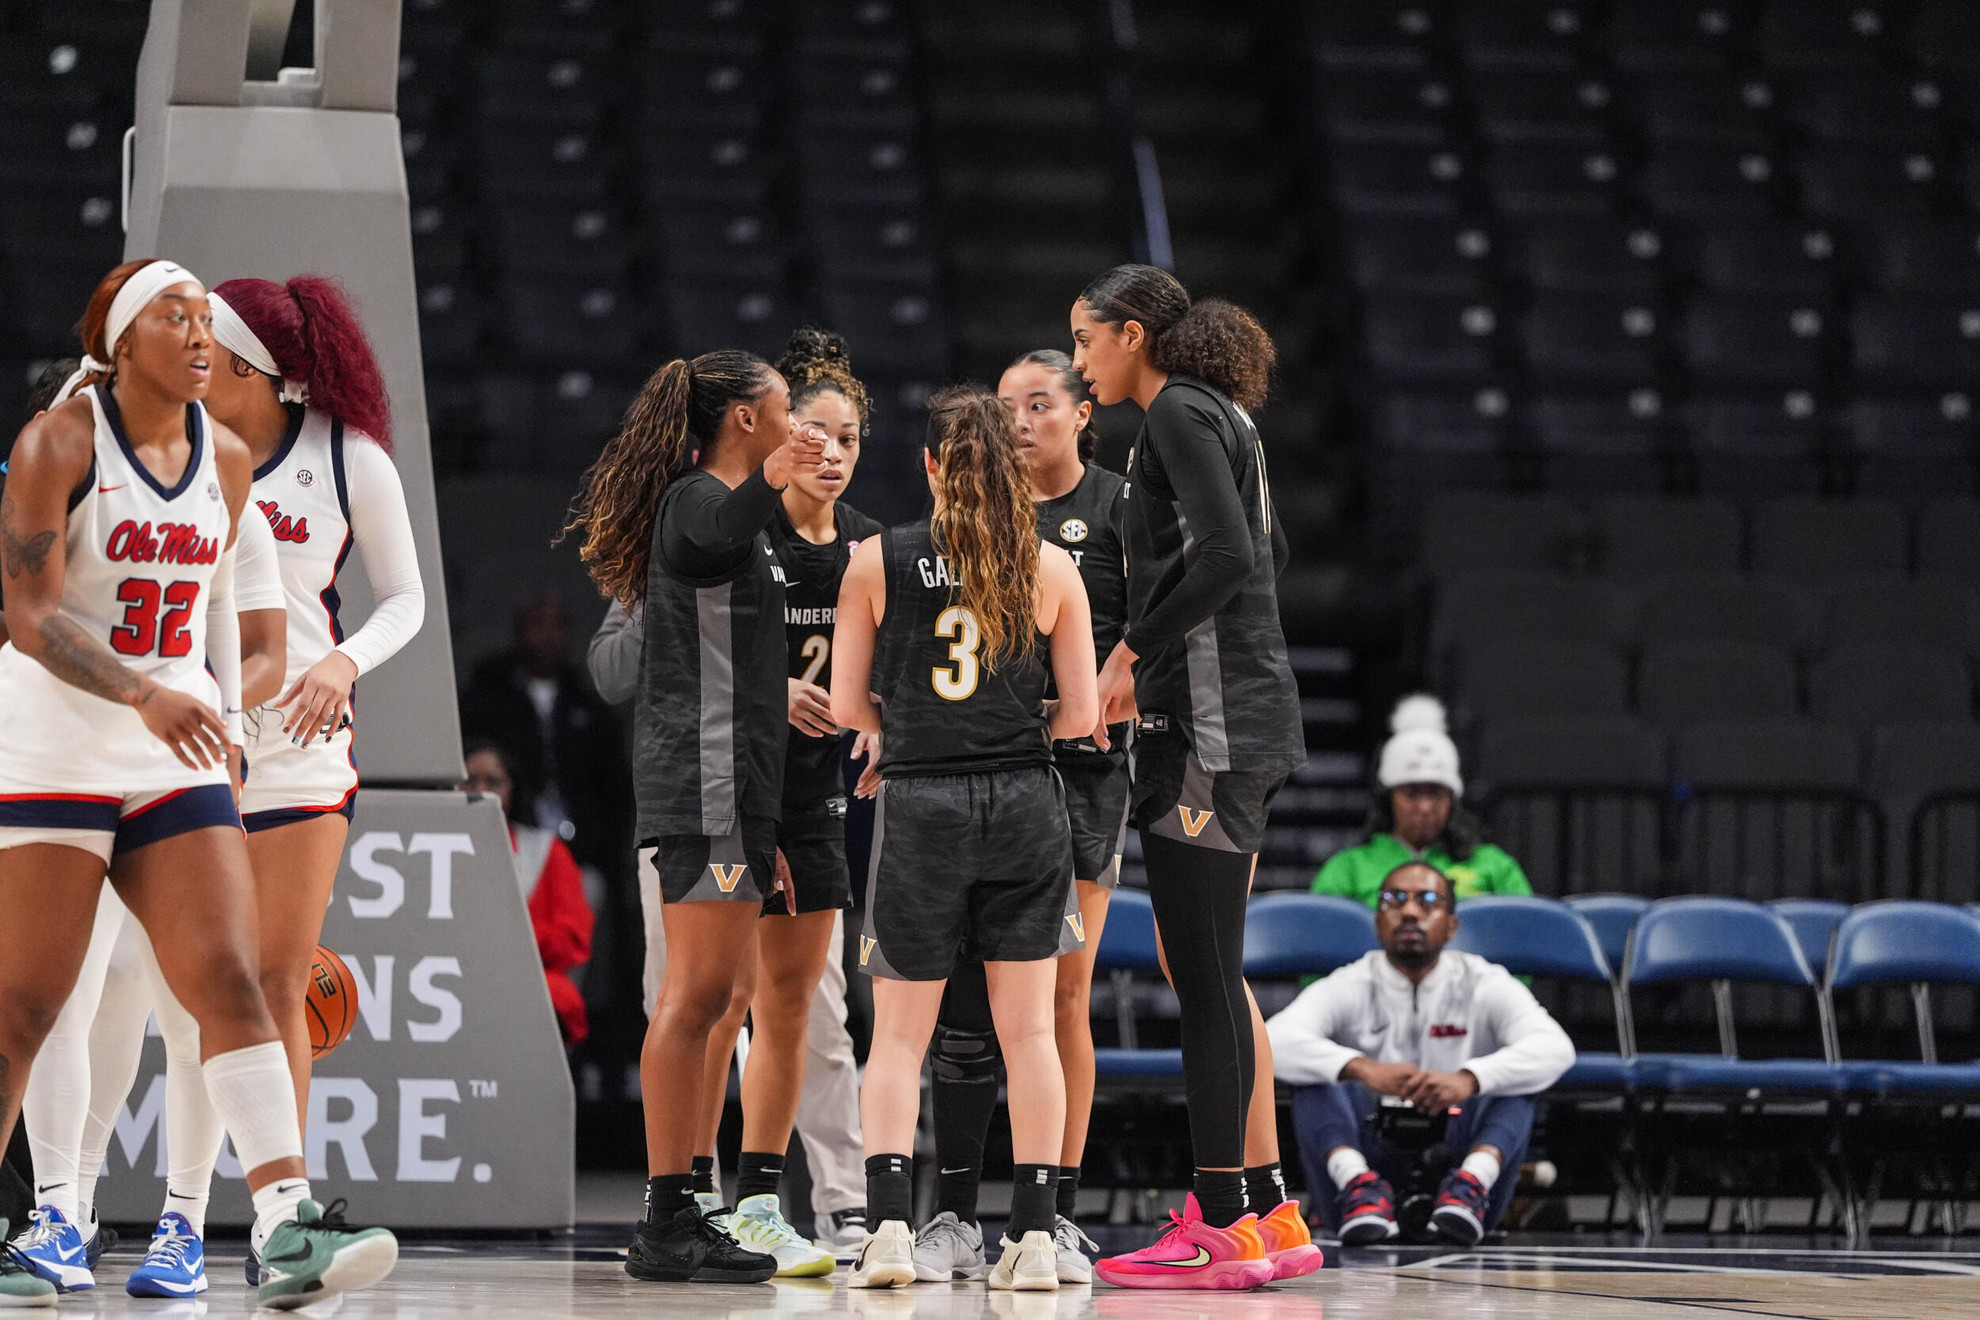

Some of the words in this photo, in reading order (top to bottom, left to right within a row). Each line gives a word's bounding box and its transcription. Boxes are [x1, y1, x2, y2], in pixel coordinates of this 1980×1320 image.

[106, 519, 159, 563] Ole
[157, 522, 218, 565] Miss
[1060, 519, 1088, 542] SEC
[110, 577, 200, 658] 32
[801, 634, 830, 688] 2
[931, 605, 981, 701] 3
[1178, 804, 1214, 837] V
[328, 831, 476, 919] ST
[709, 863, 748, 892] V
[860, 933, 877, 966] V
[97, 1074, 493, 1183] MRE.
